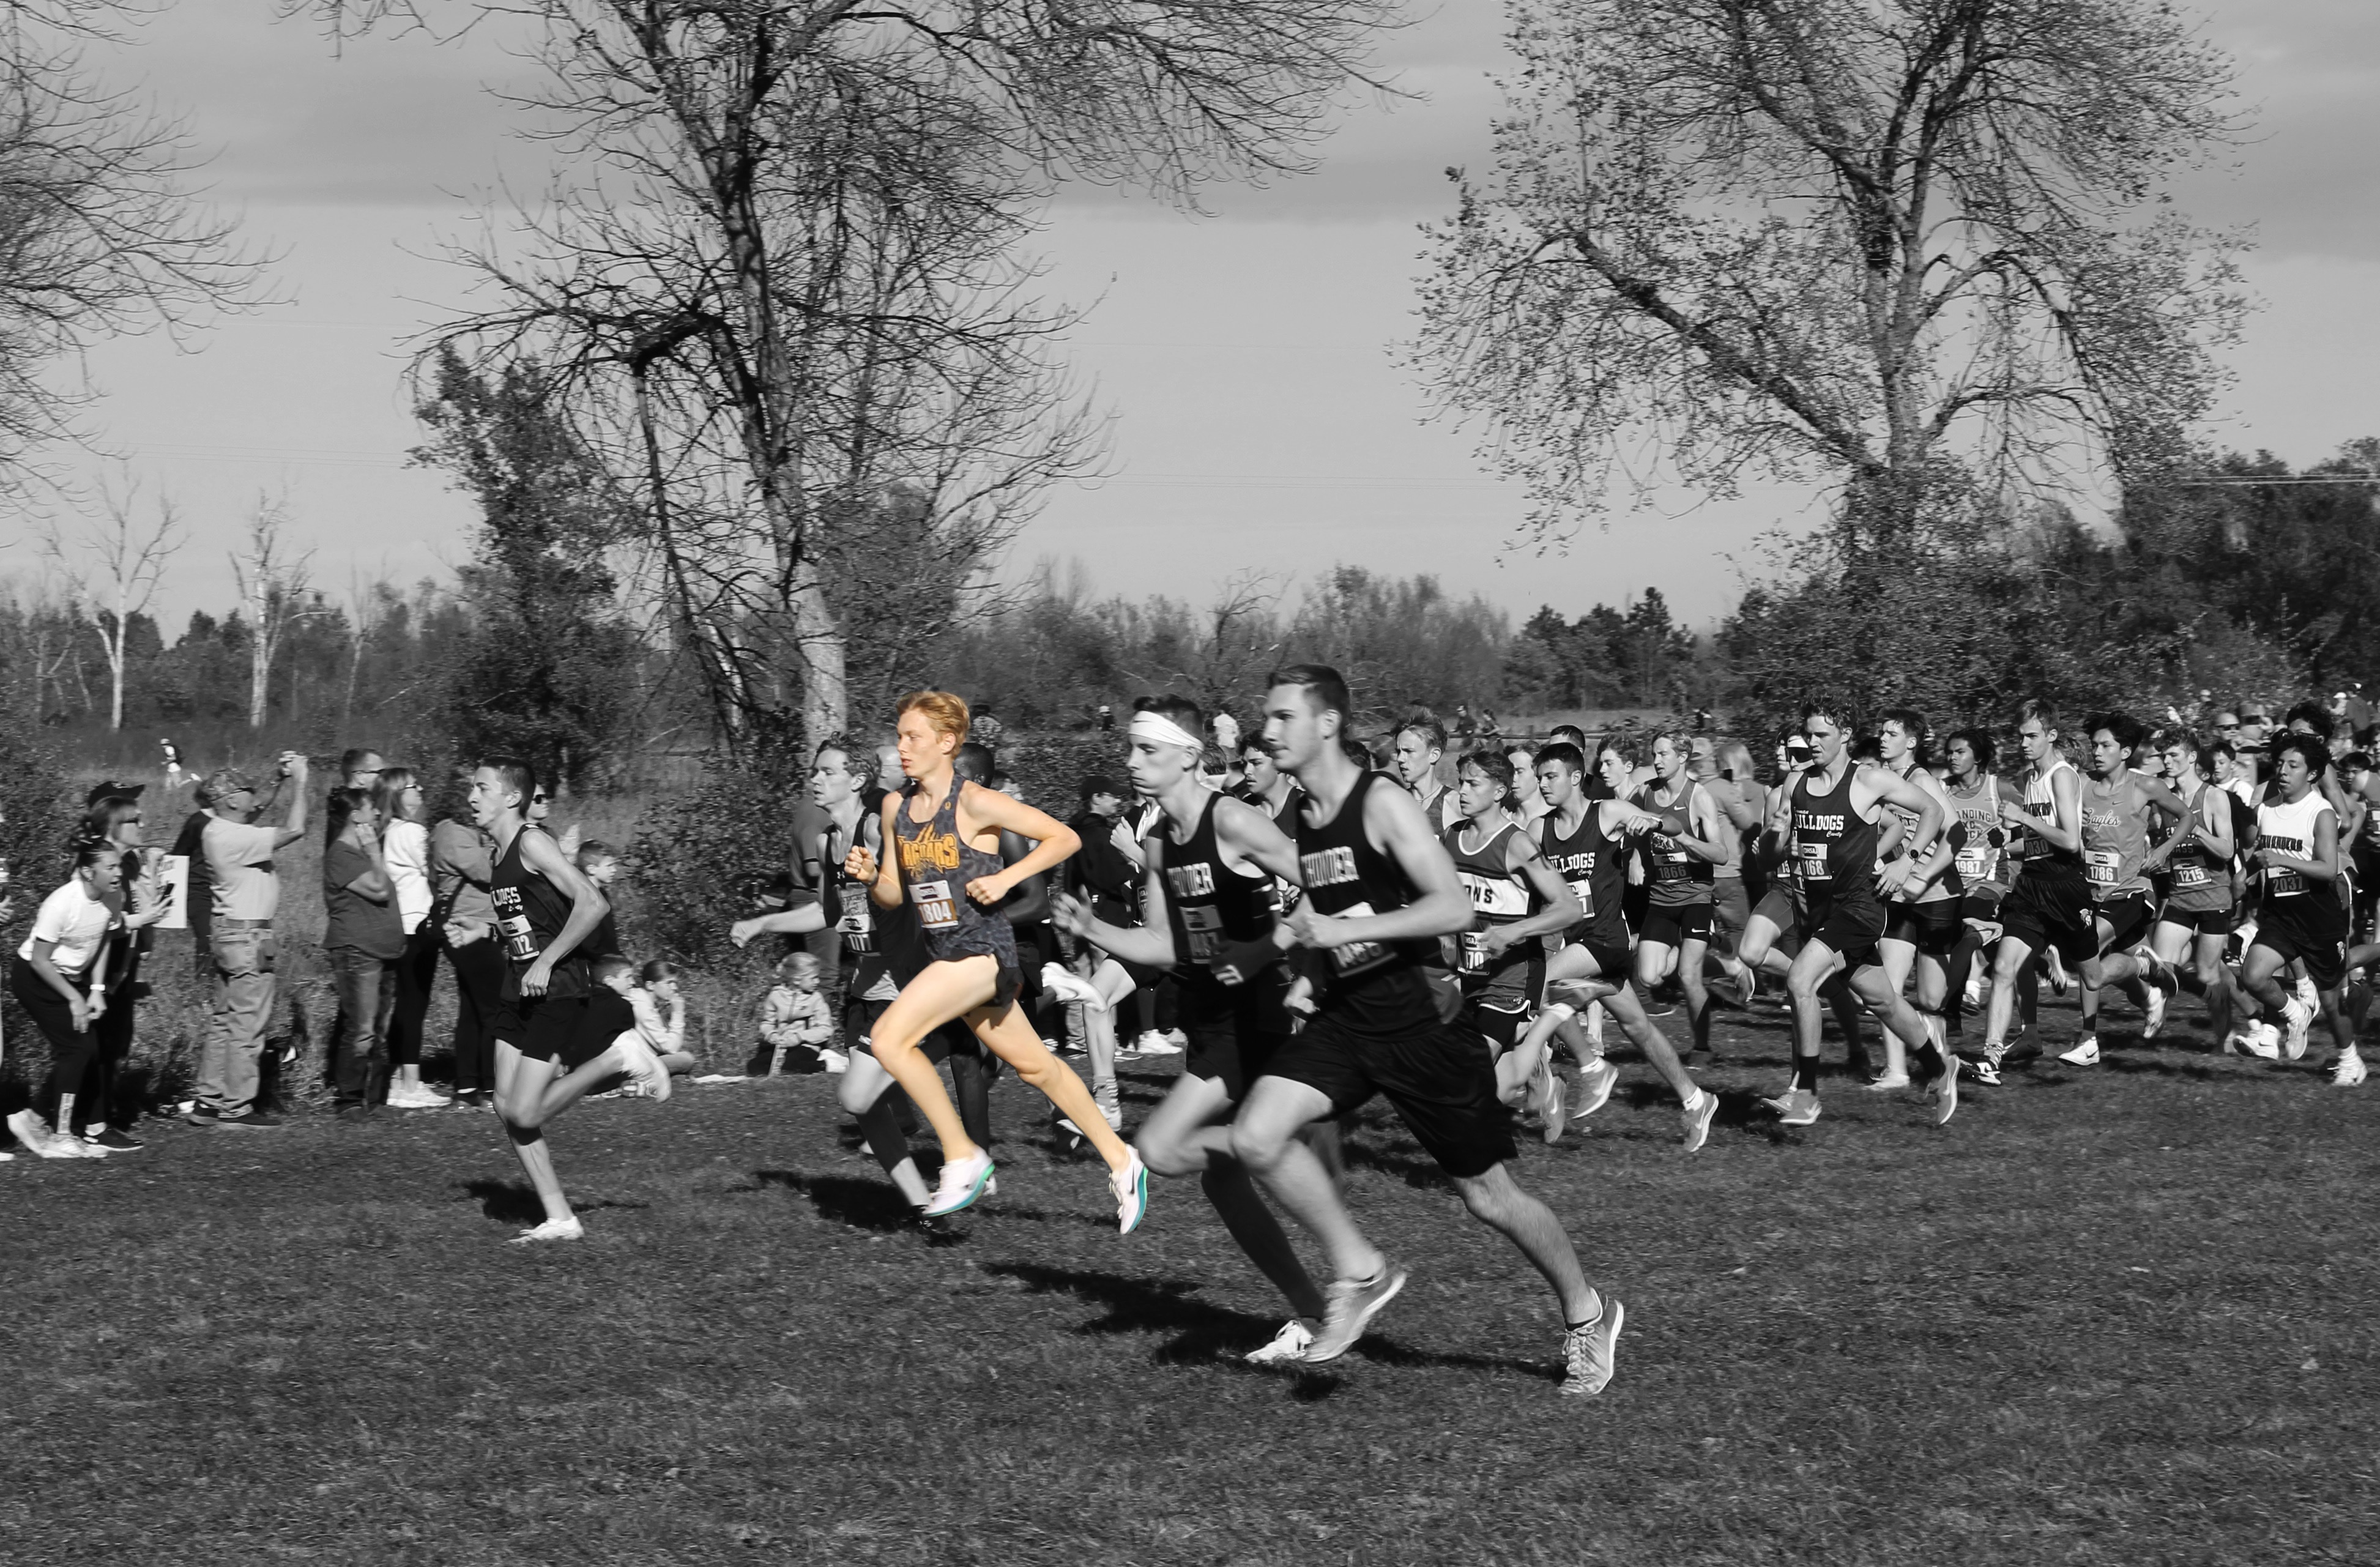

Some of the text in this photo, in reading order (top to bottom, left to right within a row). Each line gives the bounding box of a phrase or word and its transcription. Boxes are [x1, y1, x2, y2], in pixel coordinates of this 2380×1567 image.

[2025, 839, 2048, 856] 2030
[2172, 843, 2194, 854] ASS
[1658, 865, 1687, 879] 1866
[1781, 859, 1790, 874] 15
[1955, 860, 1981, 874] 1987
[2089, 865, 2114, 881] 1786
[2178, 868, 2204, 882] 1215
[2272, 876, 2303, 892] 2037
[918, 901, 953, 923] 1804
